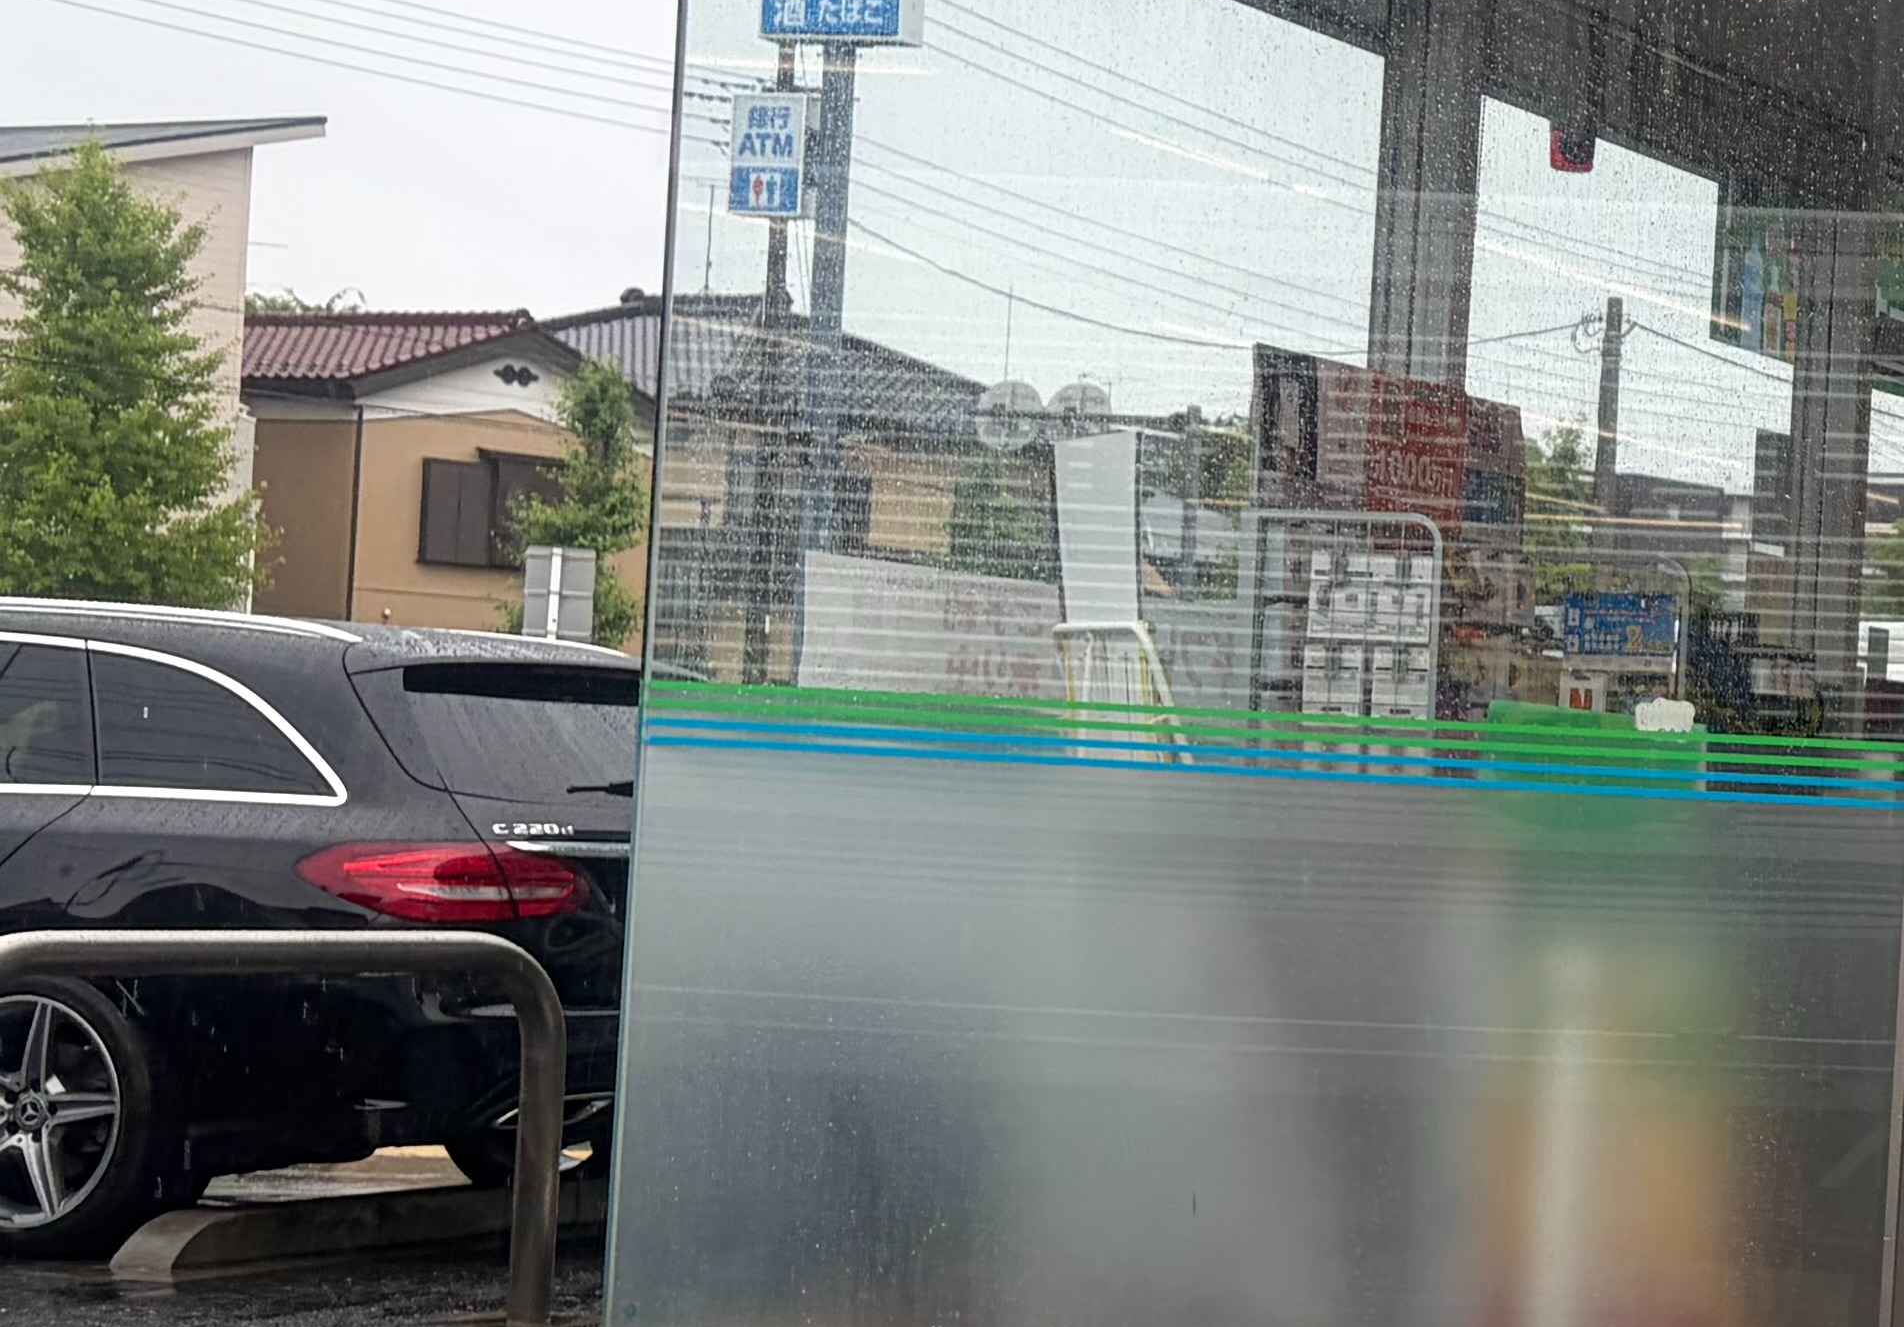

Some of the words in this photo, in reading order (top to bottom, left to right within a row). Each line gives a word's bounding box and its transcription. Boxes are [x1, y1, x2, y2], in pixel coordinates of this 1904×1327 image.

[747, 105, 791, 131] 銀行
[738, 132, 793, 158] ATM
[492, 822, 509, 835] C
[512, 822, 560, 835] 220
